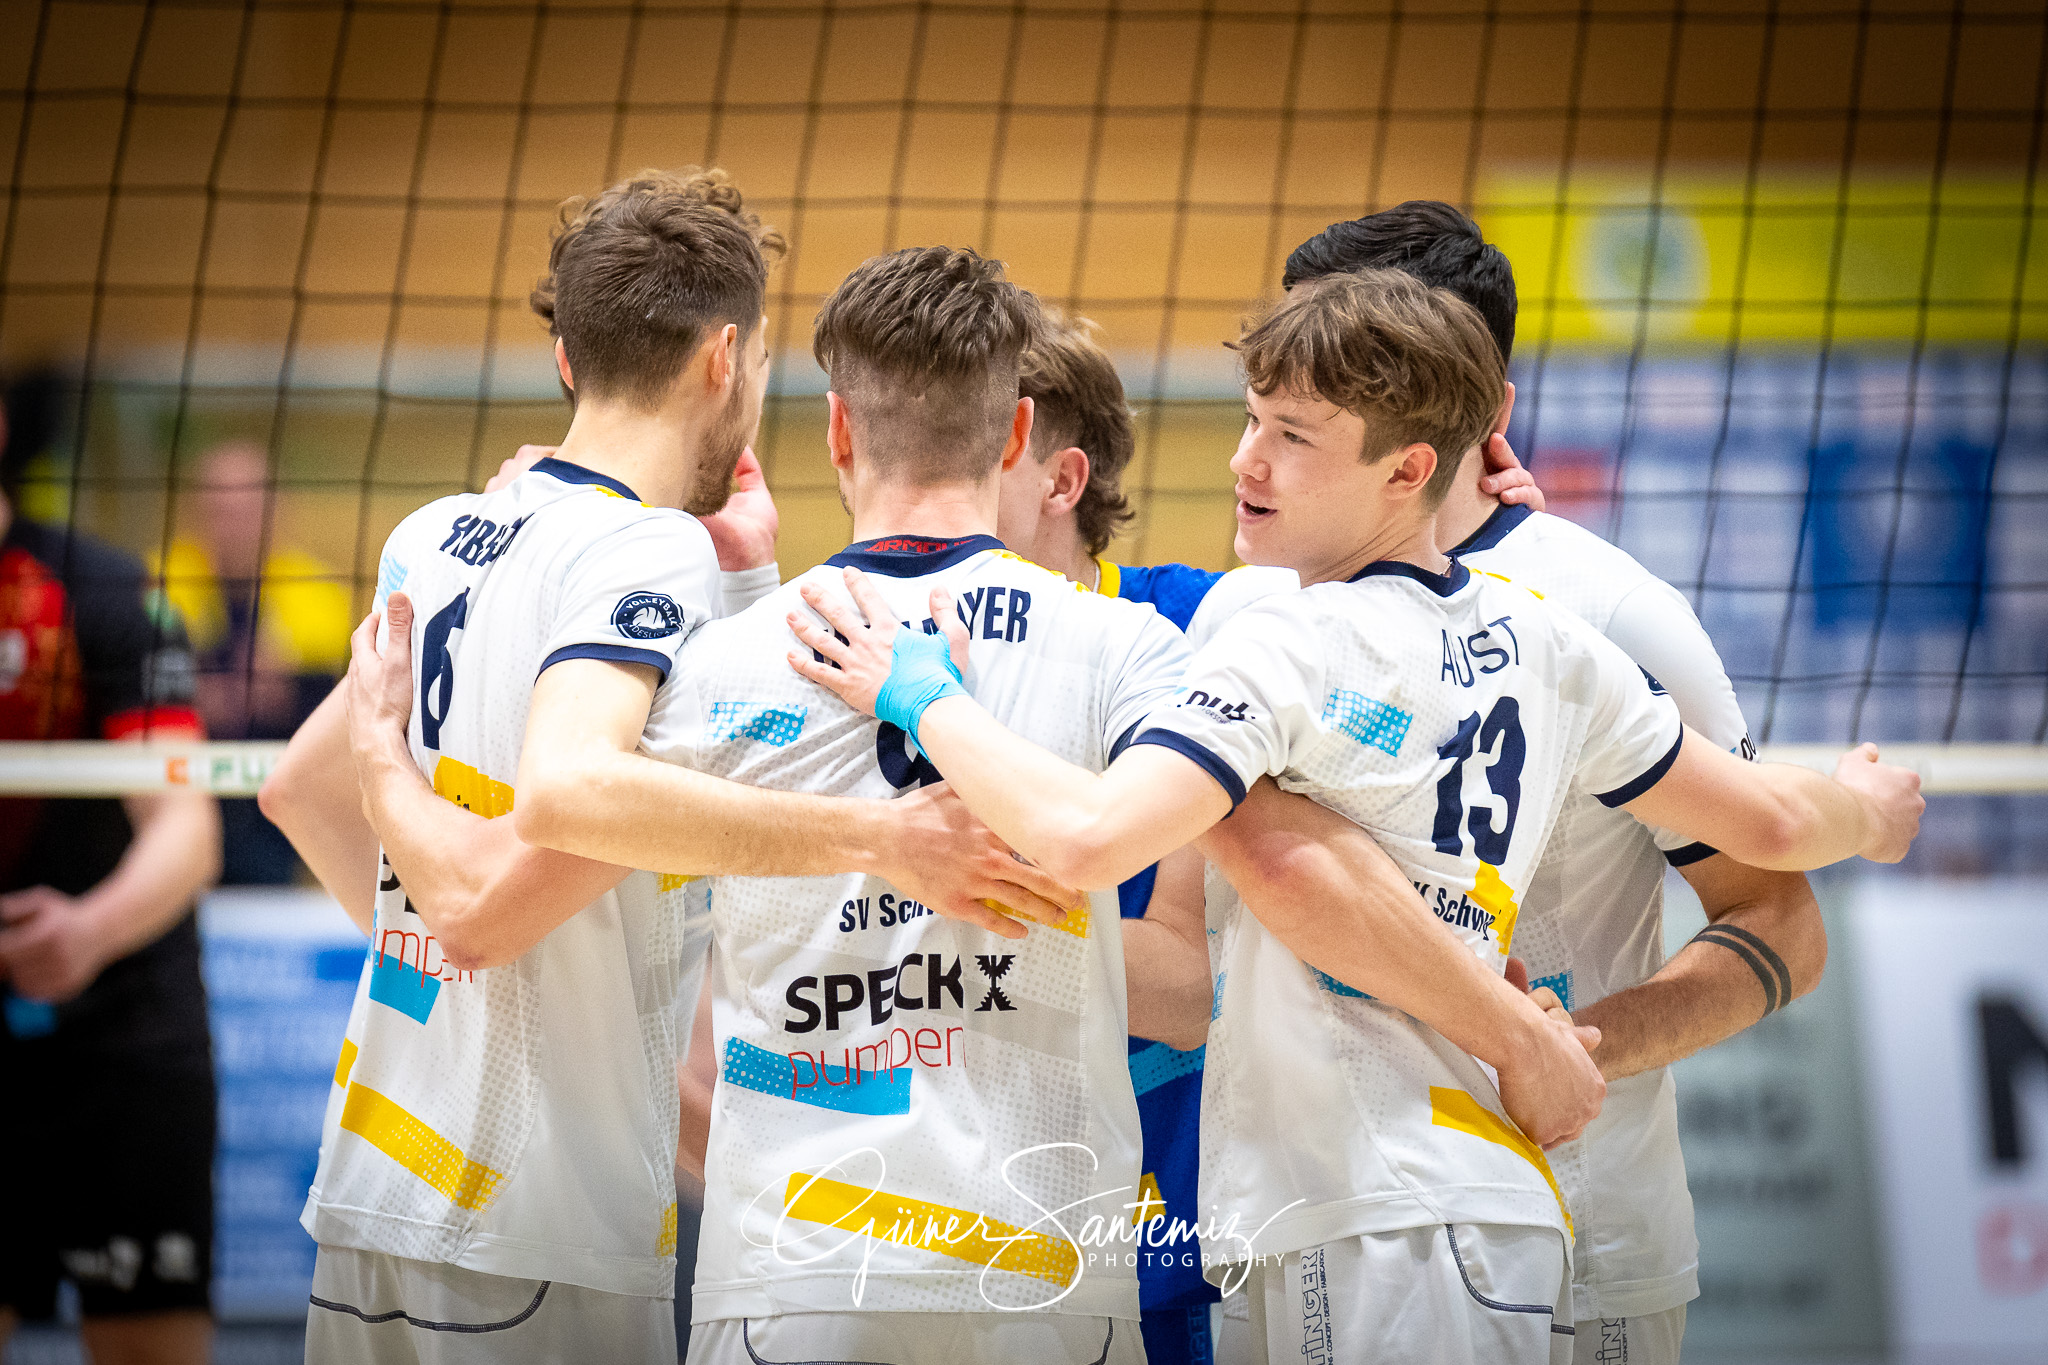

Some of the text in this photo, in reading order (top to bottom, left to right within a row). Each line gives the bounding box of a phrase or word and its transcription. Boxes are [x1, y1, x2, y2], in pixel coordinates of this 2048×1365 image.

[625, 597, 678, 626] VOLLEYBALL
[1441, 615, 1519, 688] AUST
[1432, 696, 1526, 865] 13
[839, 896, 870, 933] SV
[784, 953, 964, 1034] SPECK
[788, 1026, 967, 1101] pumpen
[1322, 1293, 1331, 1318] DESIGN
